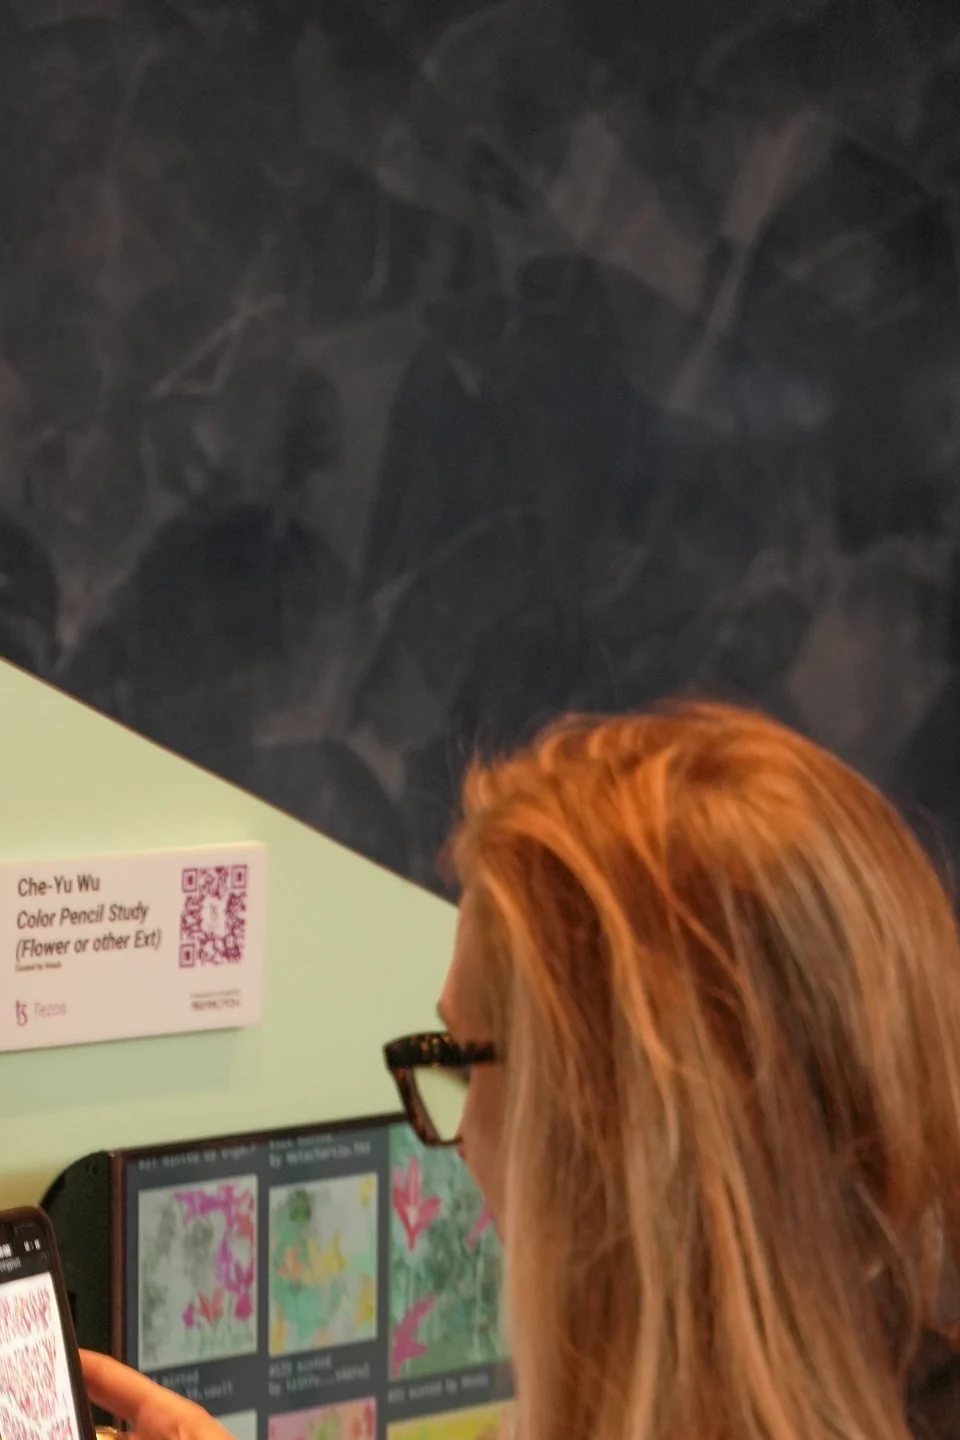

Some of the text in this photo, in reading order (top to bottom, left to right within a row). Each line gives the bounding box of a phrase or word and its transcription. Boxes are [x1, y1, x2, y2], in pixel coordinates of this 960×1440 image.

[17, 873, 100, 897] Che-Yu Wu
[17, 901, 148, 930] Color Pencil Study
[16, 928, 162, 962] (Flower or other Ext)
[34, 1002, 67, 1017] Tezos
